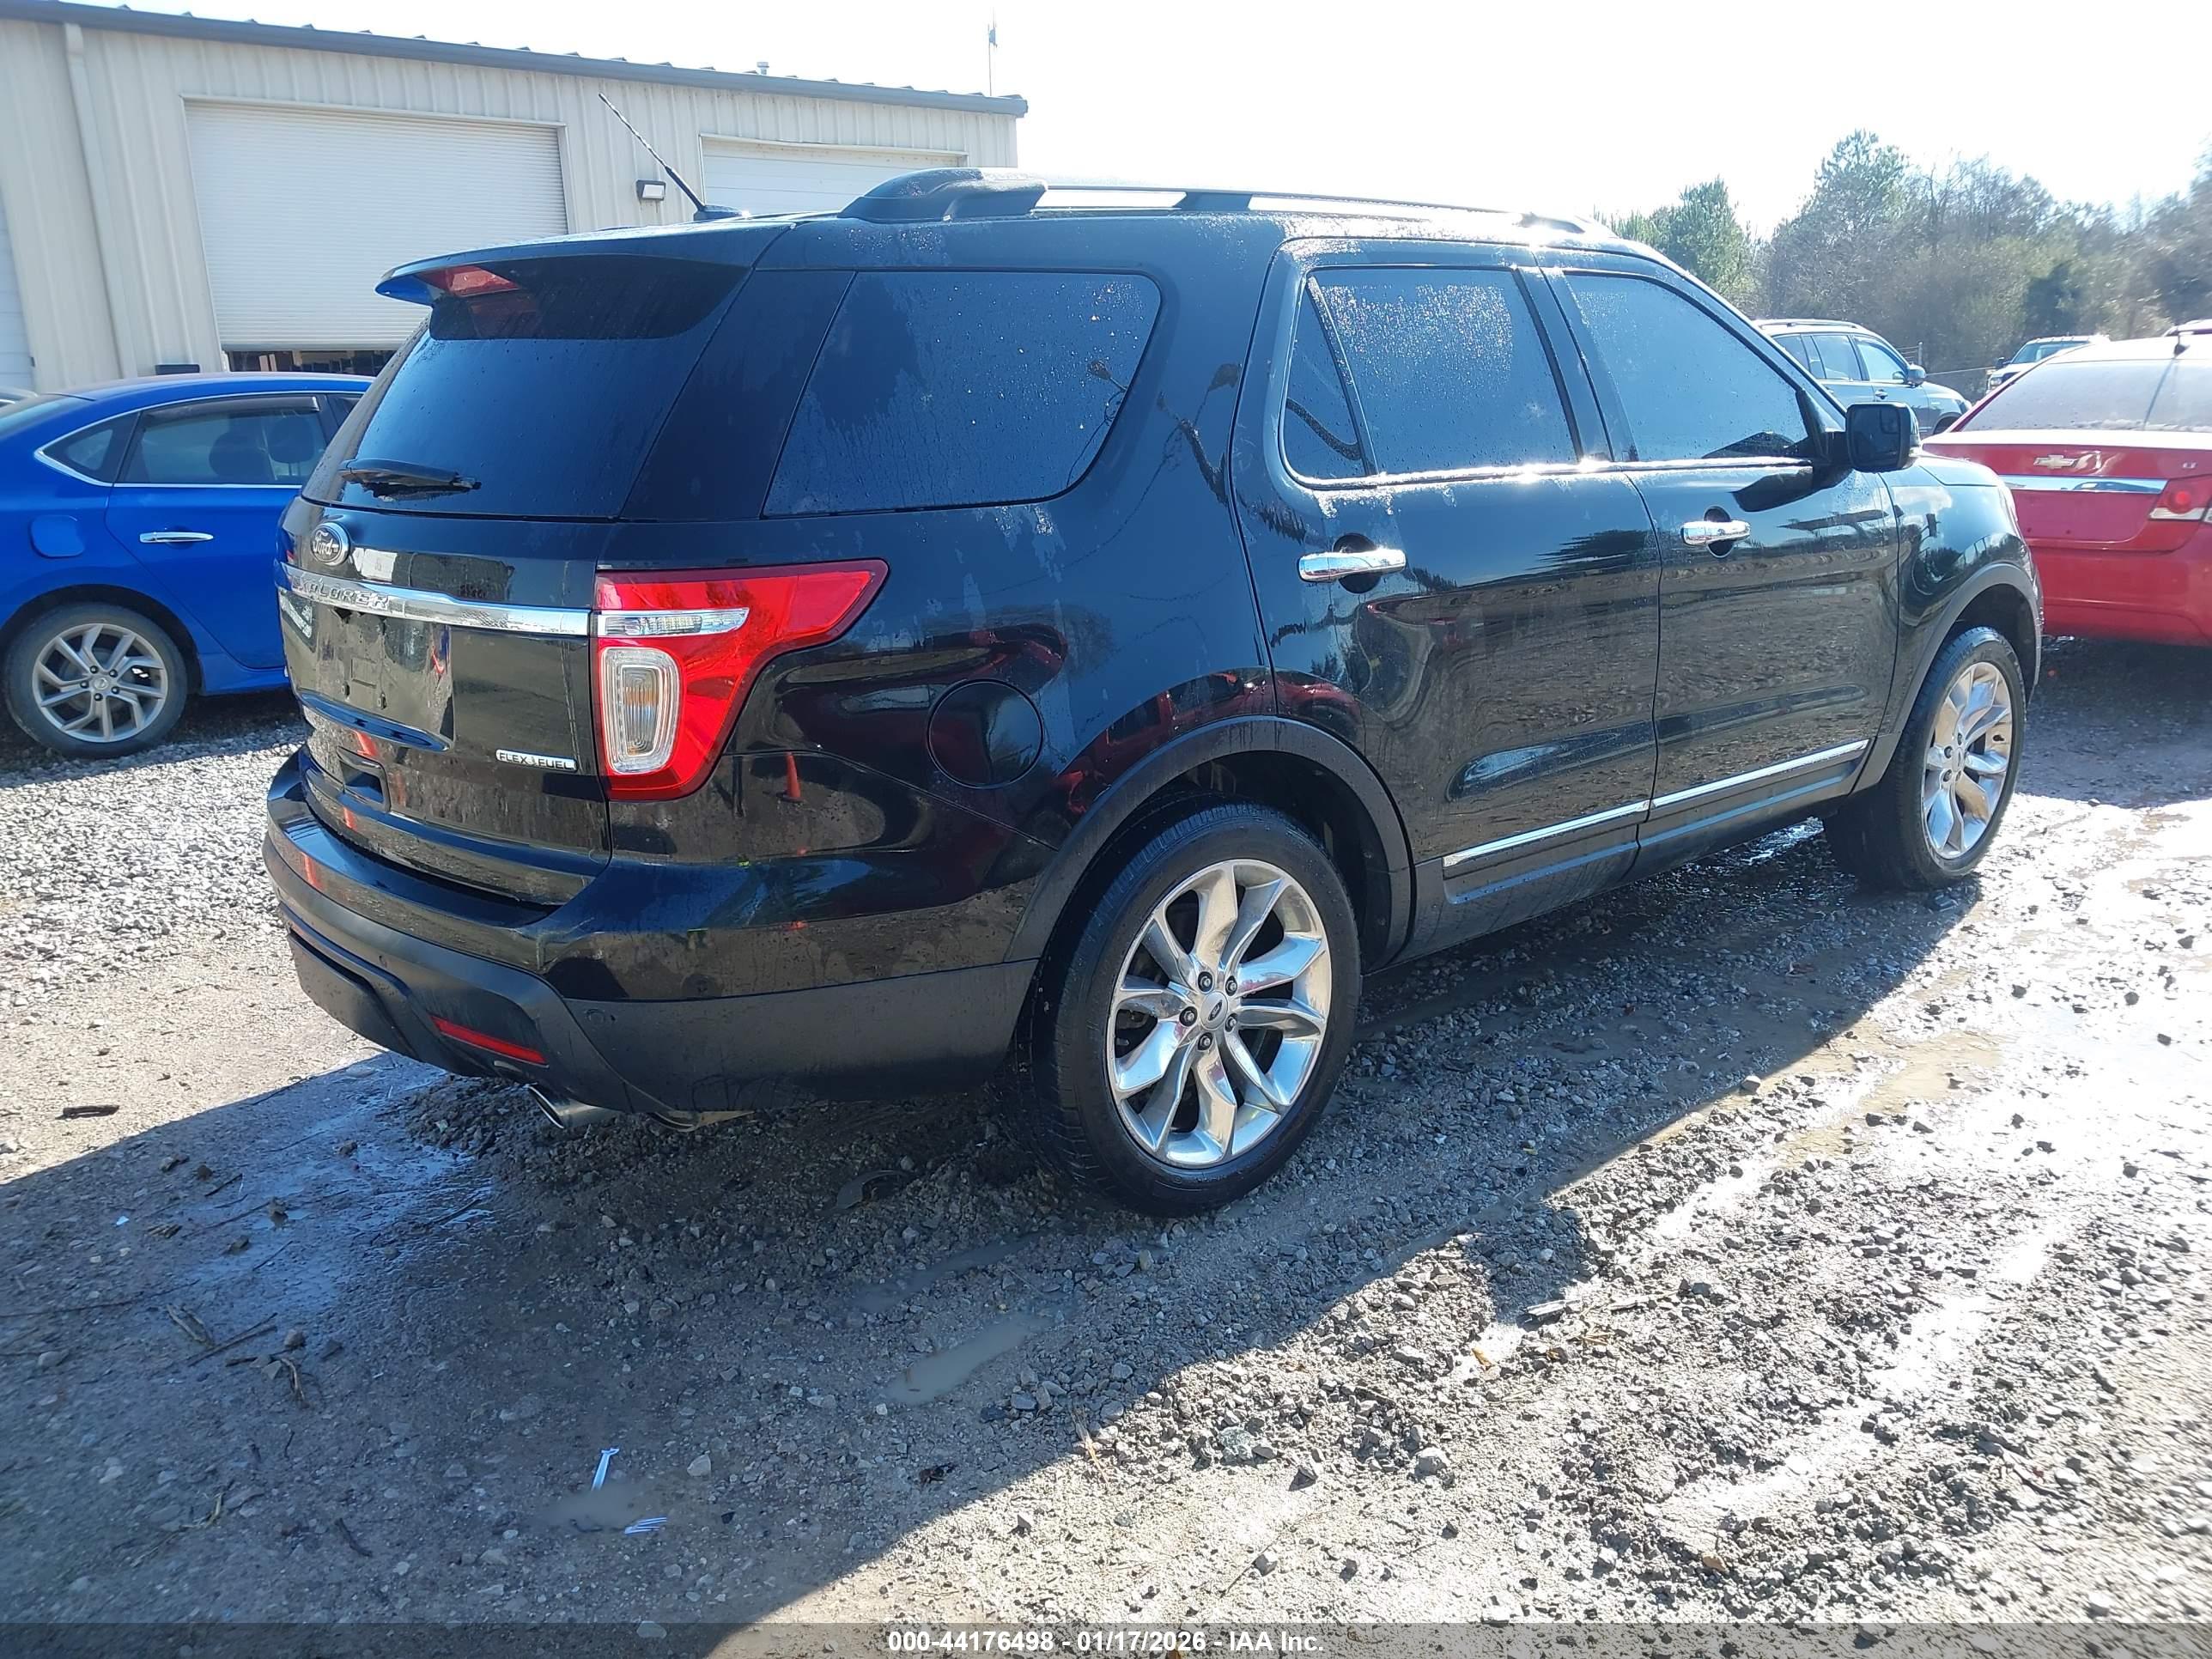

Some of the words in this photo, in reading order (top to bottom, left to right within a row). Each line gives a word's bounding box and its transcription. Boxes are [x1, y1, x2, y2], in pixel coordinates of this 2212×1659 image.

[312, 530, 338, 556] Ford
[292, 579, 390, 610] EXPLORER
[499, 752, 528, 765] FLEX
[538, 757, 573, 770] FUEL
